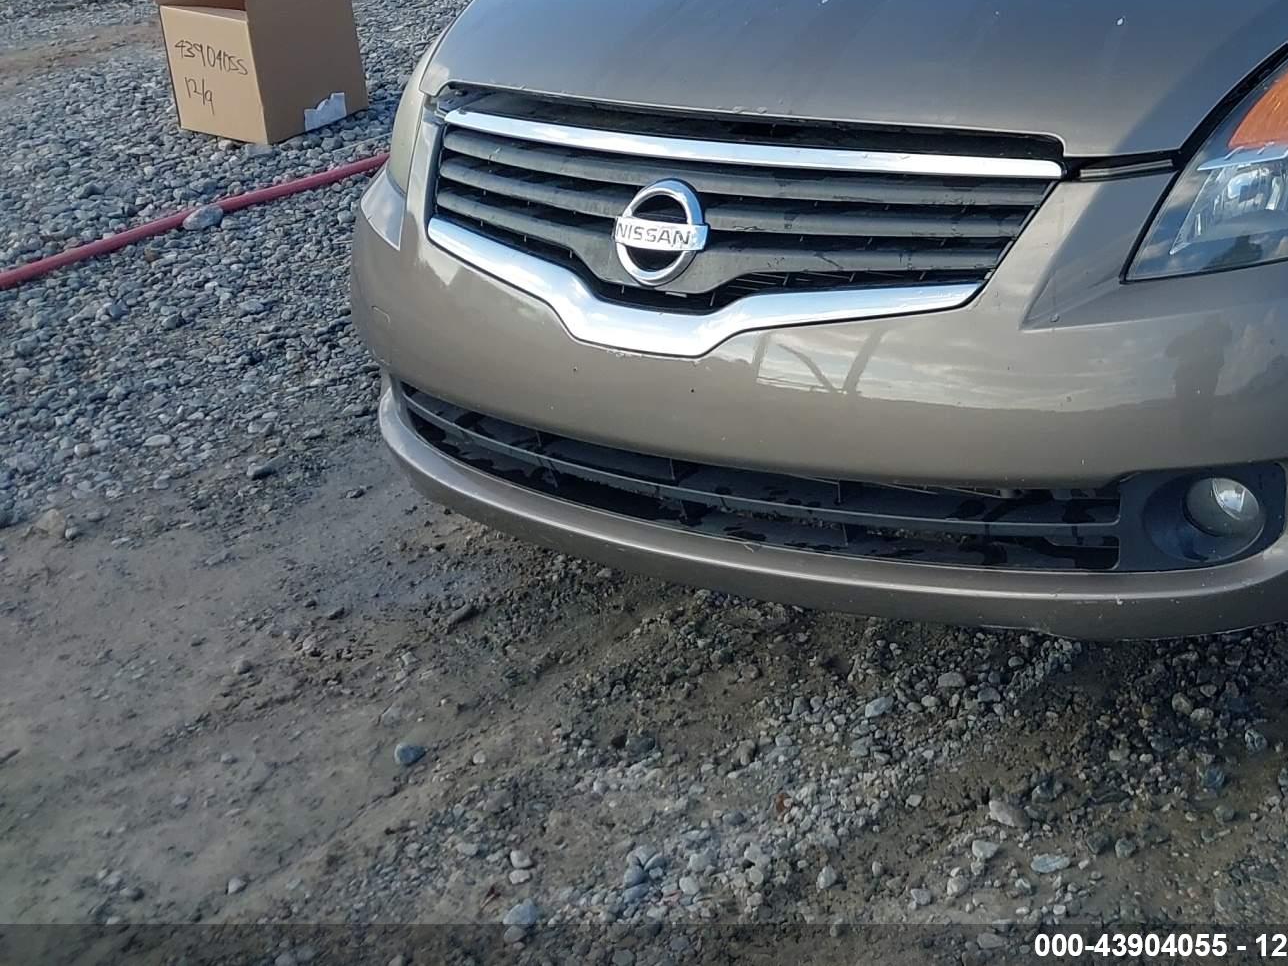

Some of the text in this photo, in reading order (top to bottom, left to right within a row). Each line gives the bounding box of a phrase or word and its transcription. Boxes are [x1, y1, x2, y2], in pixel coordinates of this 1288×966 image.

[174, 39, 248, 75] 43904055
[184, 76, 215, 115] 12/9
[616, 222, 691, 245] NISSAN
